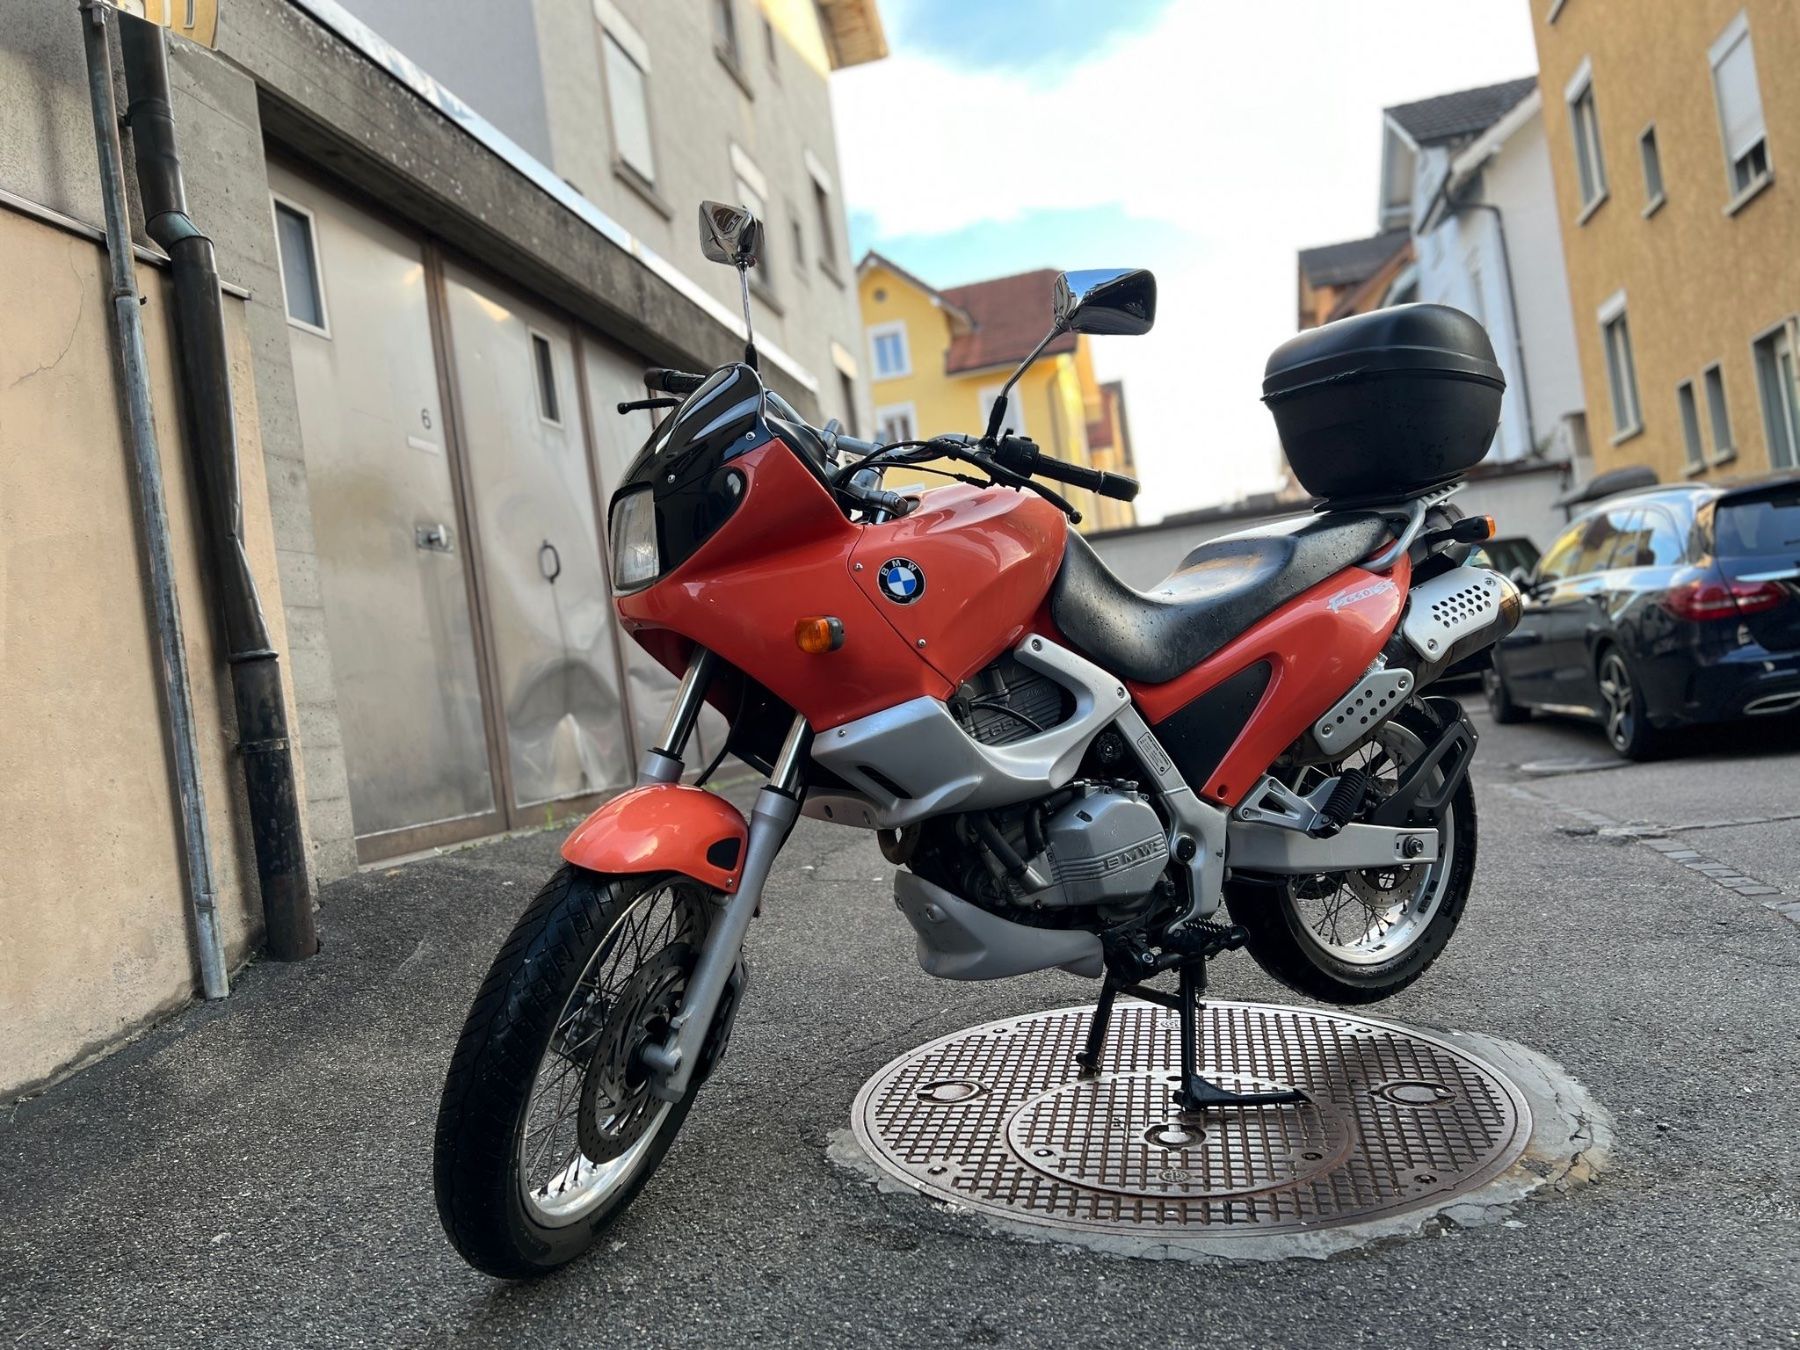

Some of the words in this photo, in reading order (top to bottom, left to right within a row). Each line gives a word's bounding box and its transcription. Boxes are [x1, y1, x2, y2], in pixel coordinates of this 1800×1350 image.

[420, 408, 432, 430] 6
[880, 559, 917, 577] BMW
[1106, 842, 1156, 870] BMW
